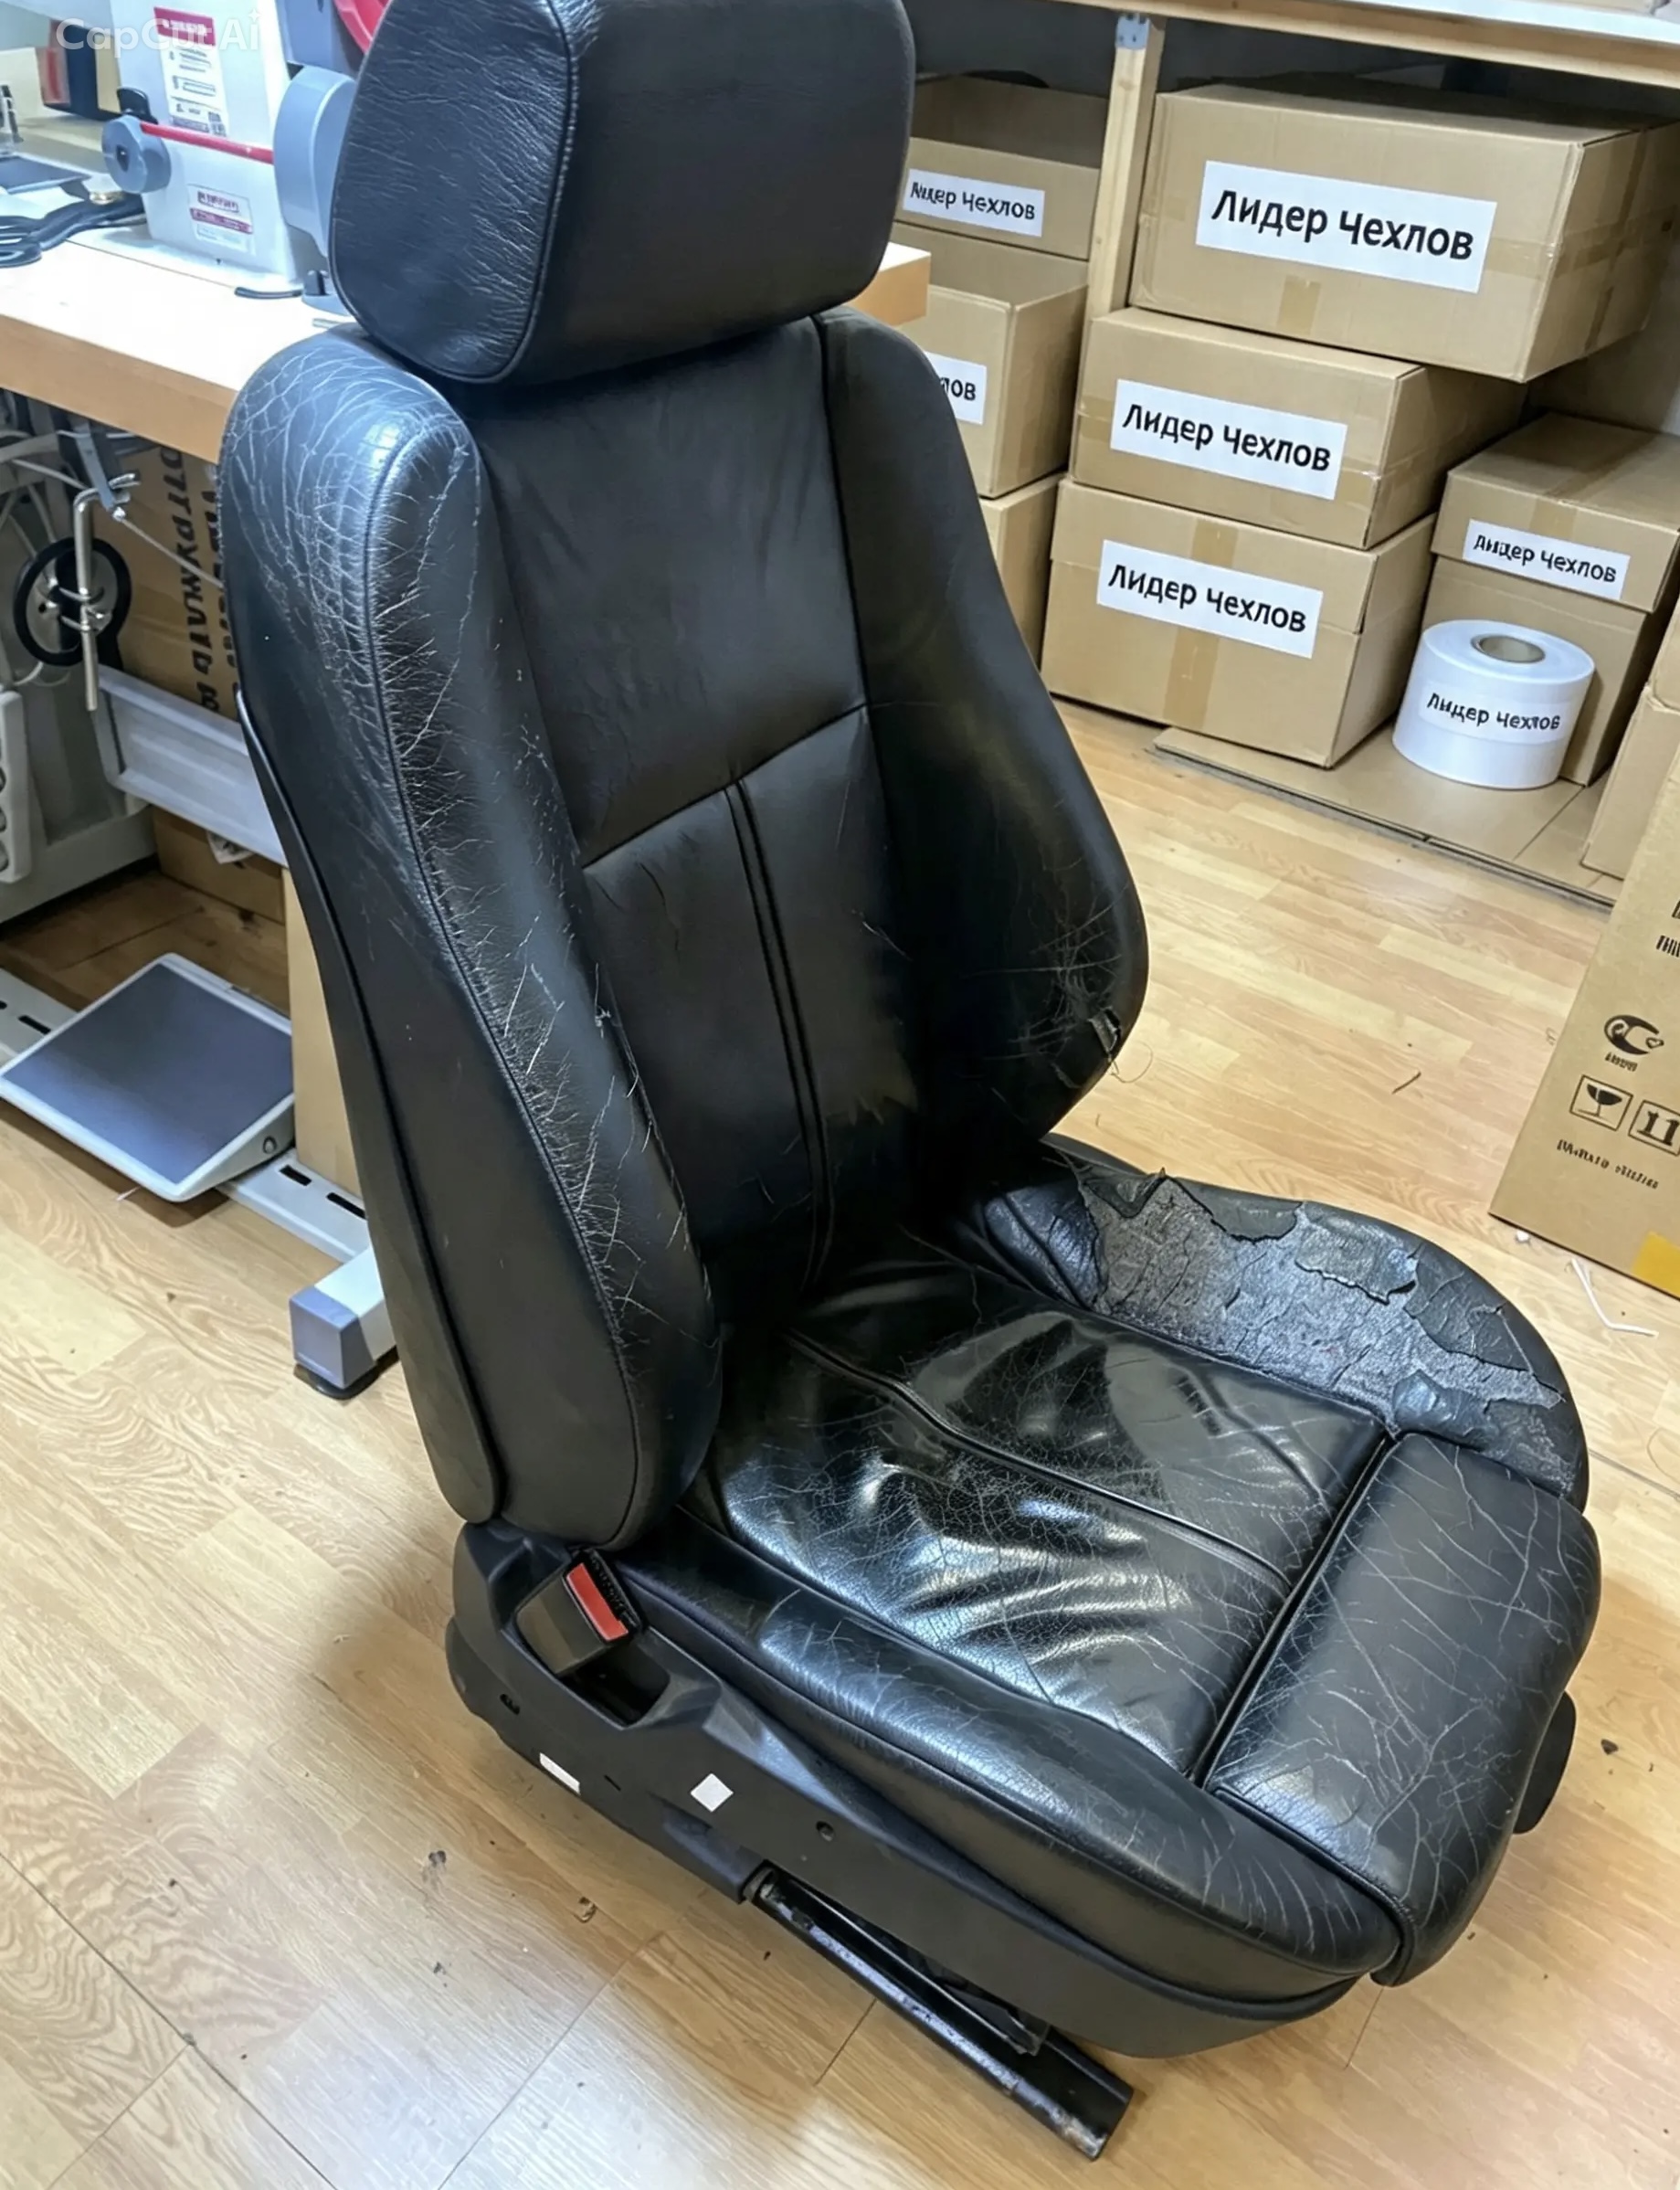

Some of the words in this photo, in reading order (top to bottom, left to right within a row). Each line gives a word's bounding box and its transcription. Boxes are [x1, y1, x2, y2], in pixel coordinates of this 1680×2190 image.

[1210, 190, 1328, 243] Лидер
[1339, 210, 1474, 260] Чехлов
[1122, 404, 1214, 450] Лидер
[1223, 425, 1331, 471] Чехлов
[1108, 564, 1197, 609] Лидер
[1207, 587, 1306, 632] Чехлов
